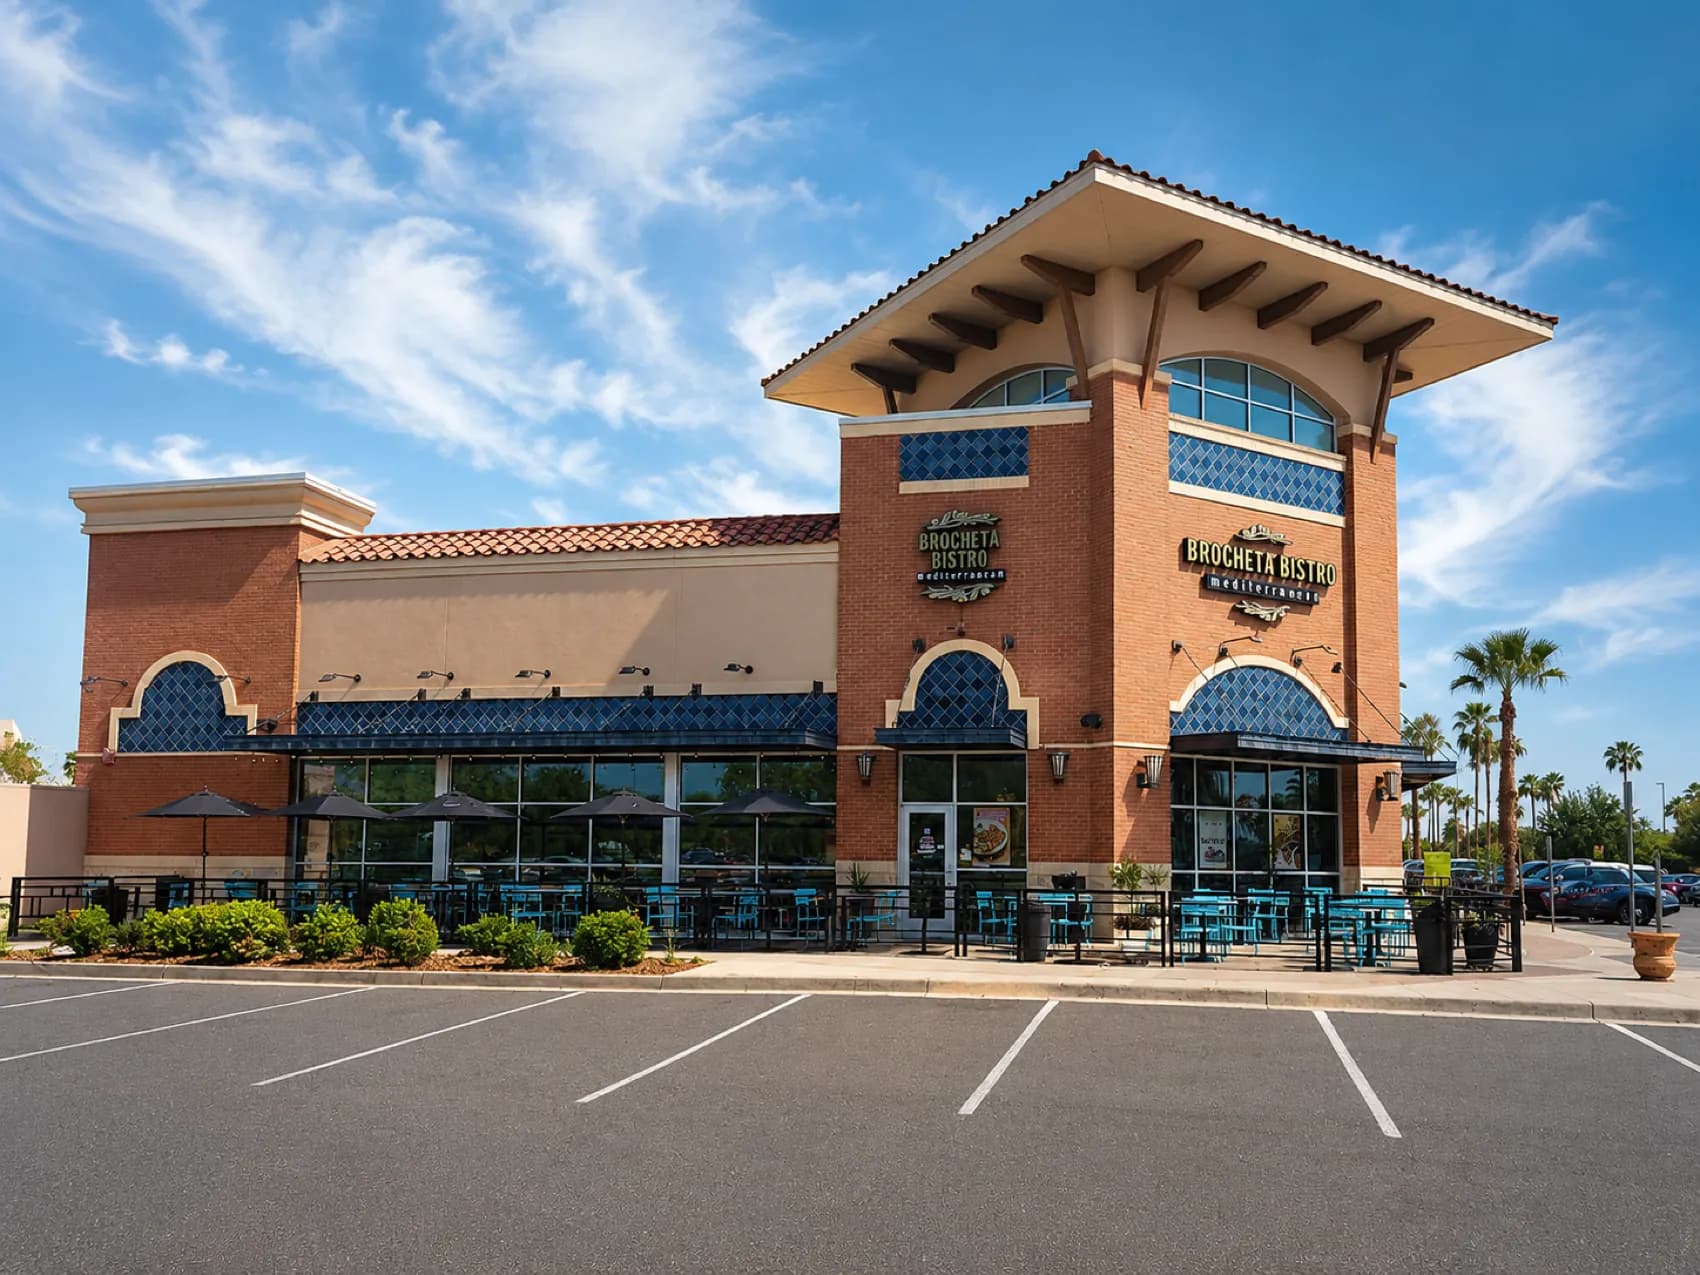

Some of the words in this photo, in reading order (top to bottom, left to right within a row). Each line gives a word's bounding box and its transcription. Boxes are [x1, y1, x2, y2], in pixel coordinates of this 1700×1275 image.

[920, 529, 1000, 551] BROCHETA
[932, 549, 987, 569] BISTRO
[1186, 538, 1275, 577] BROCHETA
[1280, 554, 1337, 586] BISTRO
